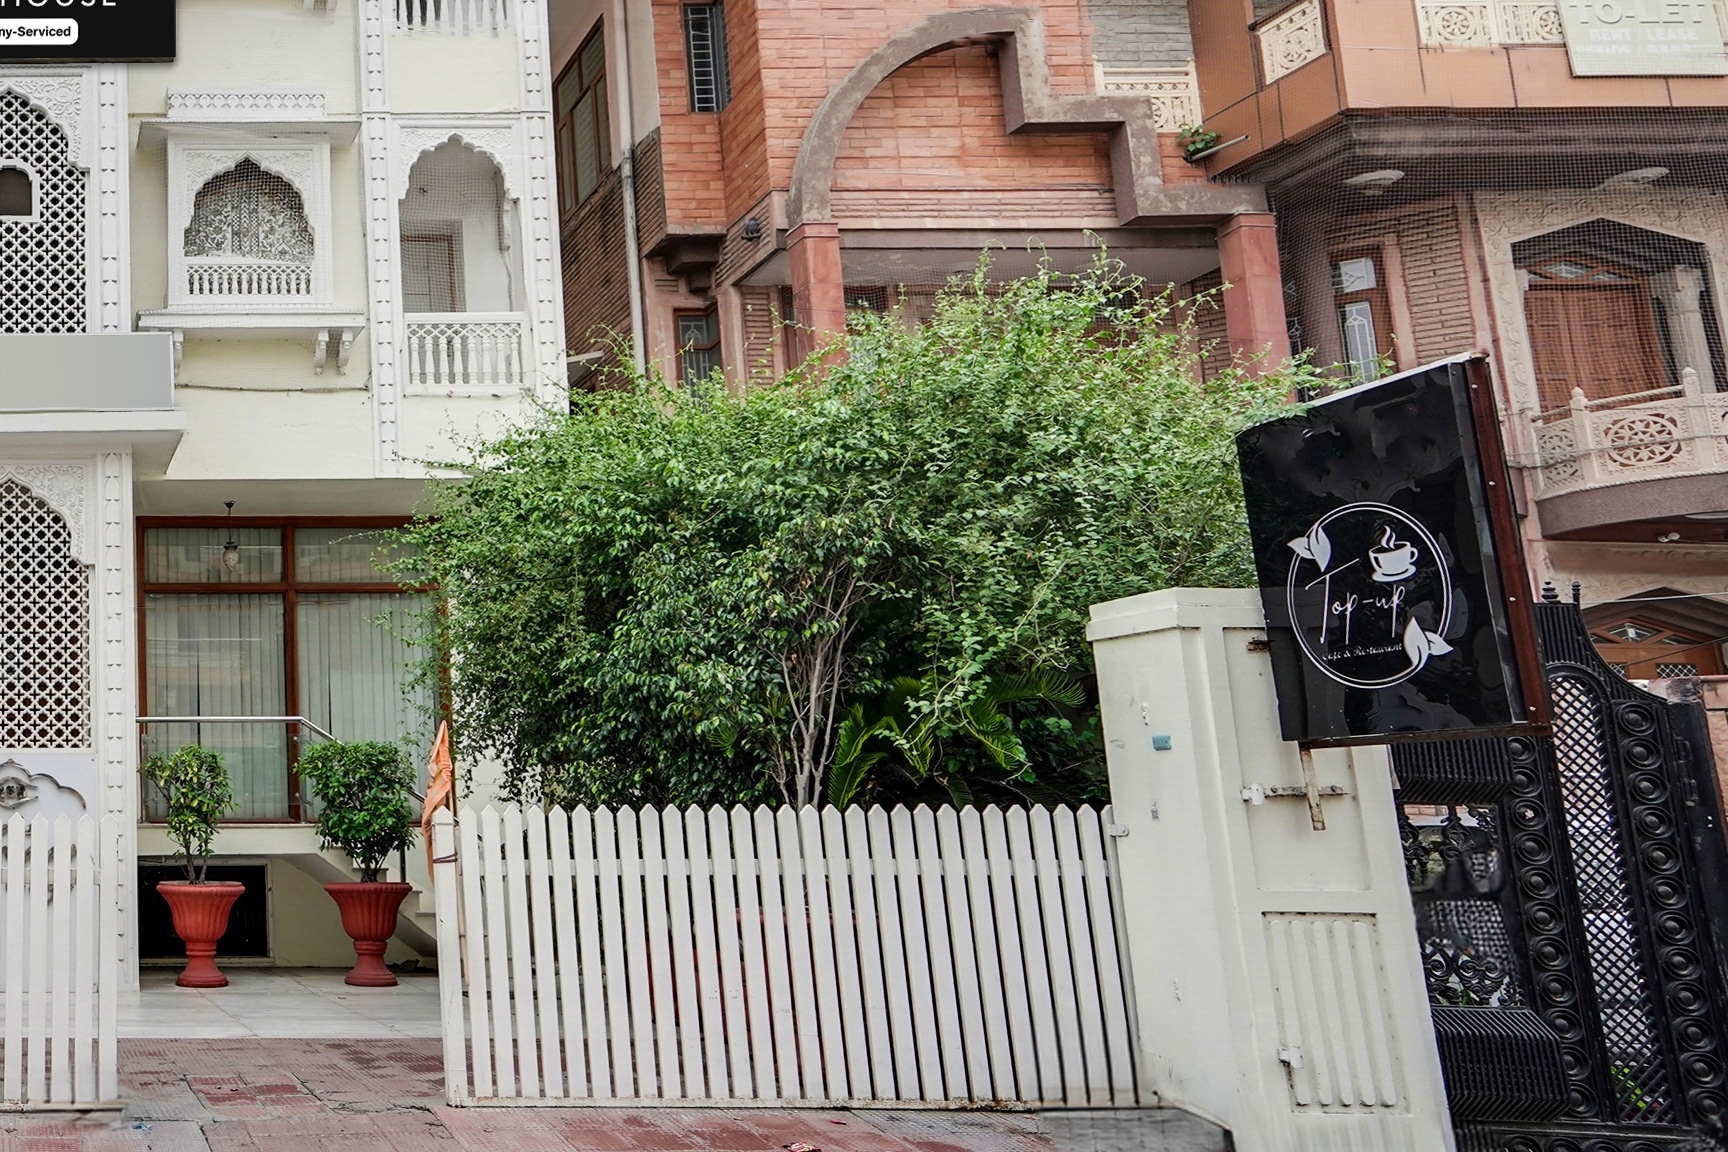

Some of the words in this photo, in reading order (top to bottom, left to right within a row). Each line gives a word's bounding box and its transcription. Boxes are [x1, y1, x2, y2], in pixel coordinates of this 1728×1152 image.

[1568, 0, 1705, 24] TO-LET
[1588, 28, 1631, 40] RENT
[1646, 28, 1698, 40] LEASE
[1304, 557, 1406, 644] Top-up
